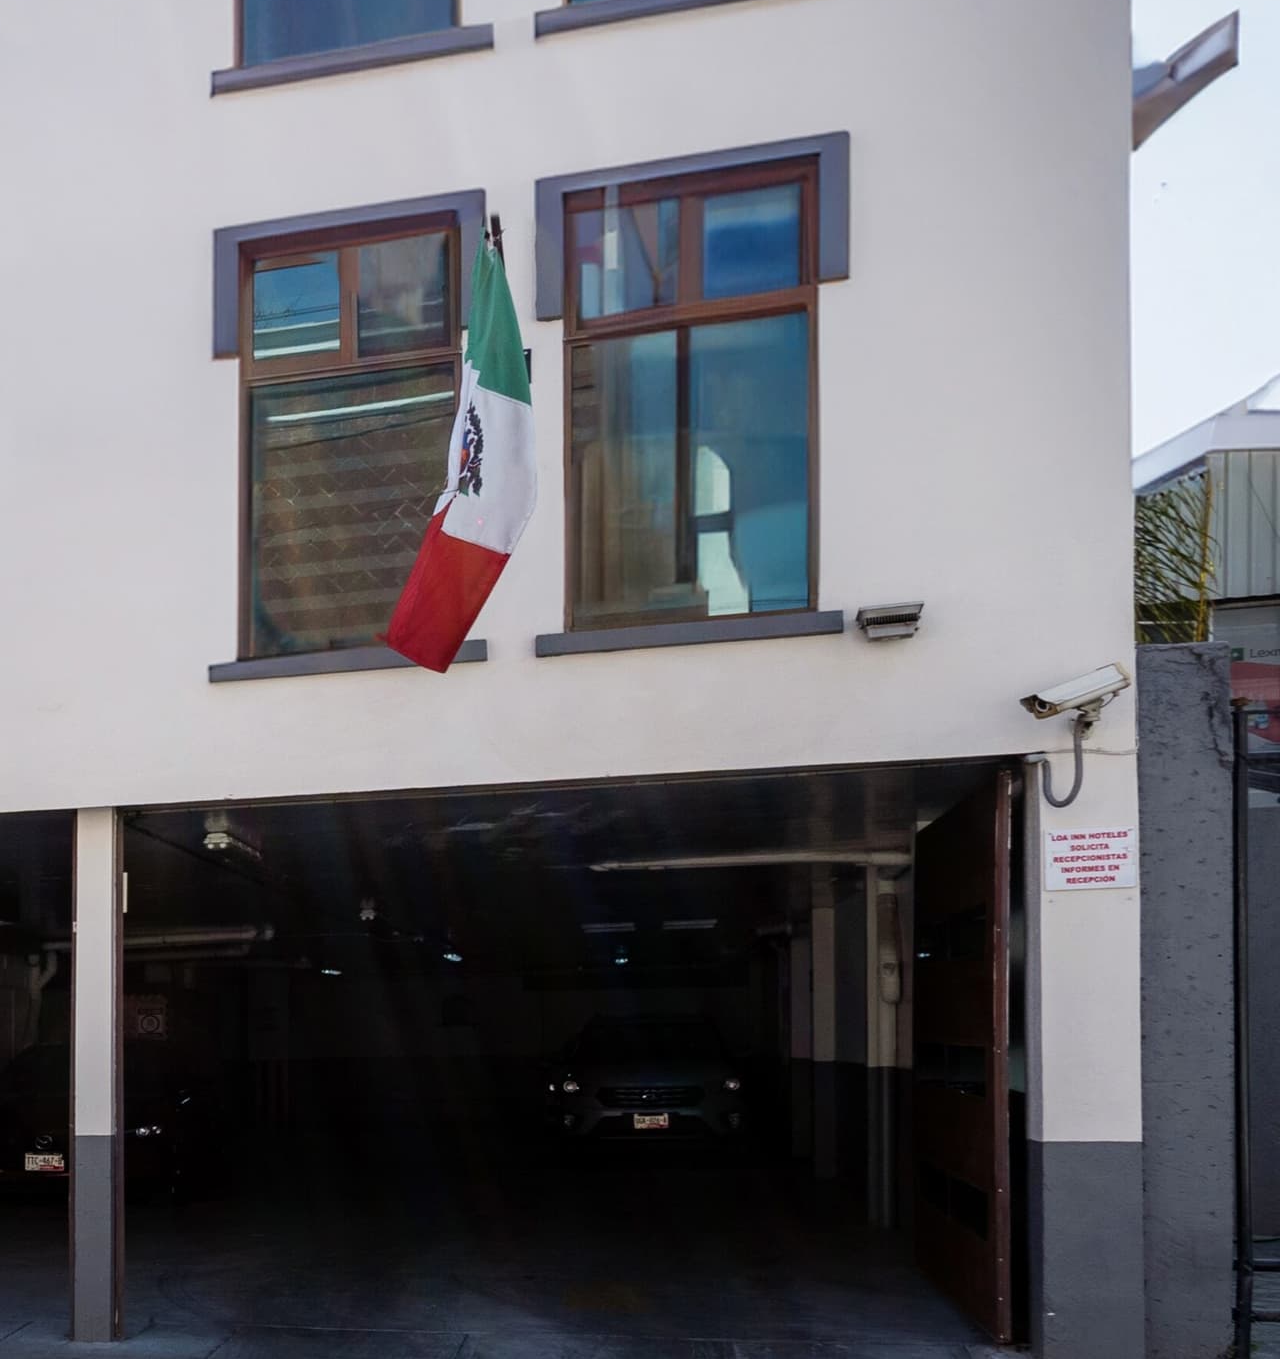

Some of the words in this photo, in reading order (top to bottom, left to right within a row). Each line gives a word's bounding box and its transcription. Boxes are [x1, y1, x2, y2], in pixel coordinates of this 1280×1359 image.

[1089, 831, 1128, 839] HOTELS
[1070, 843, 1109, 851] SOLICITA
[1053, 853, 1128, 863] RECEPCIONISTAS
[1061, 865, 1105, 873] INFORMES
